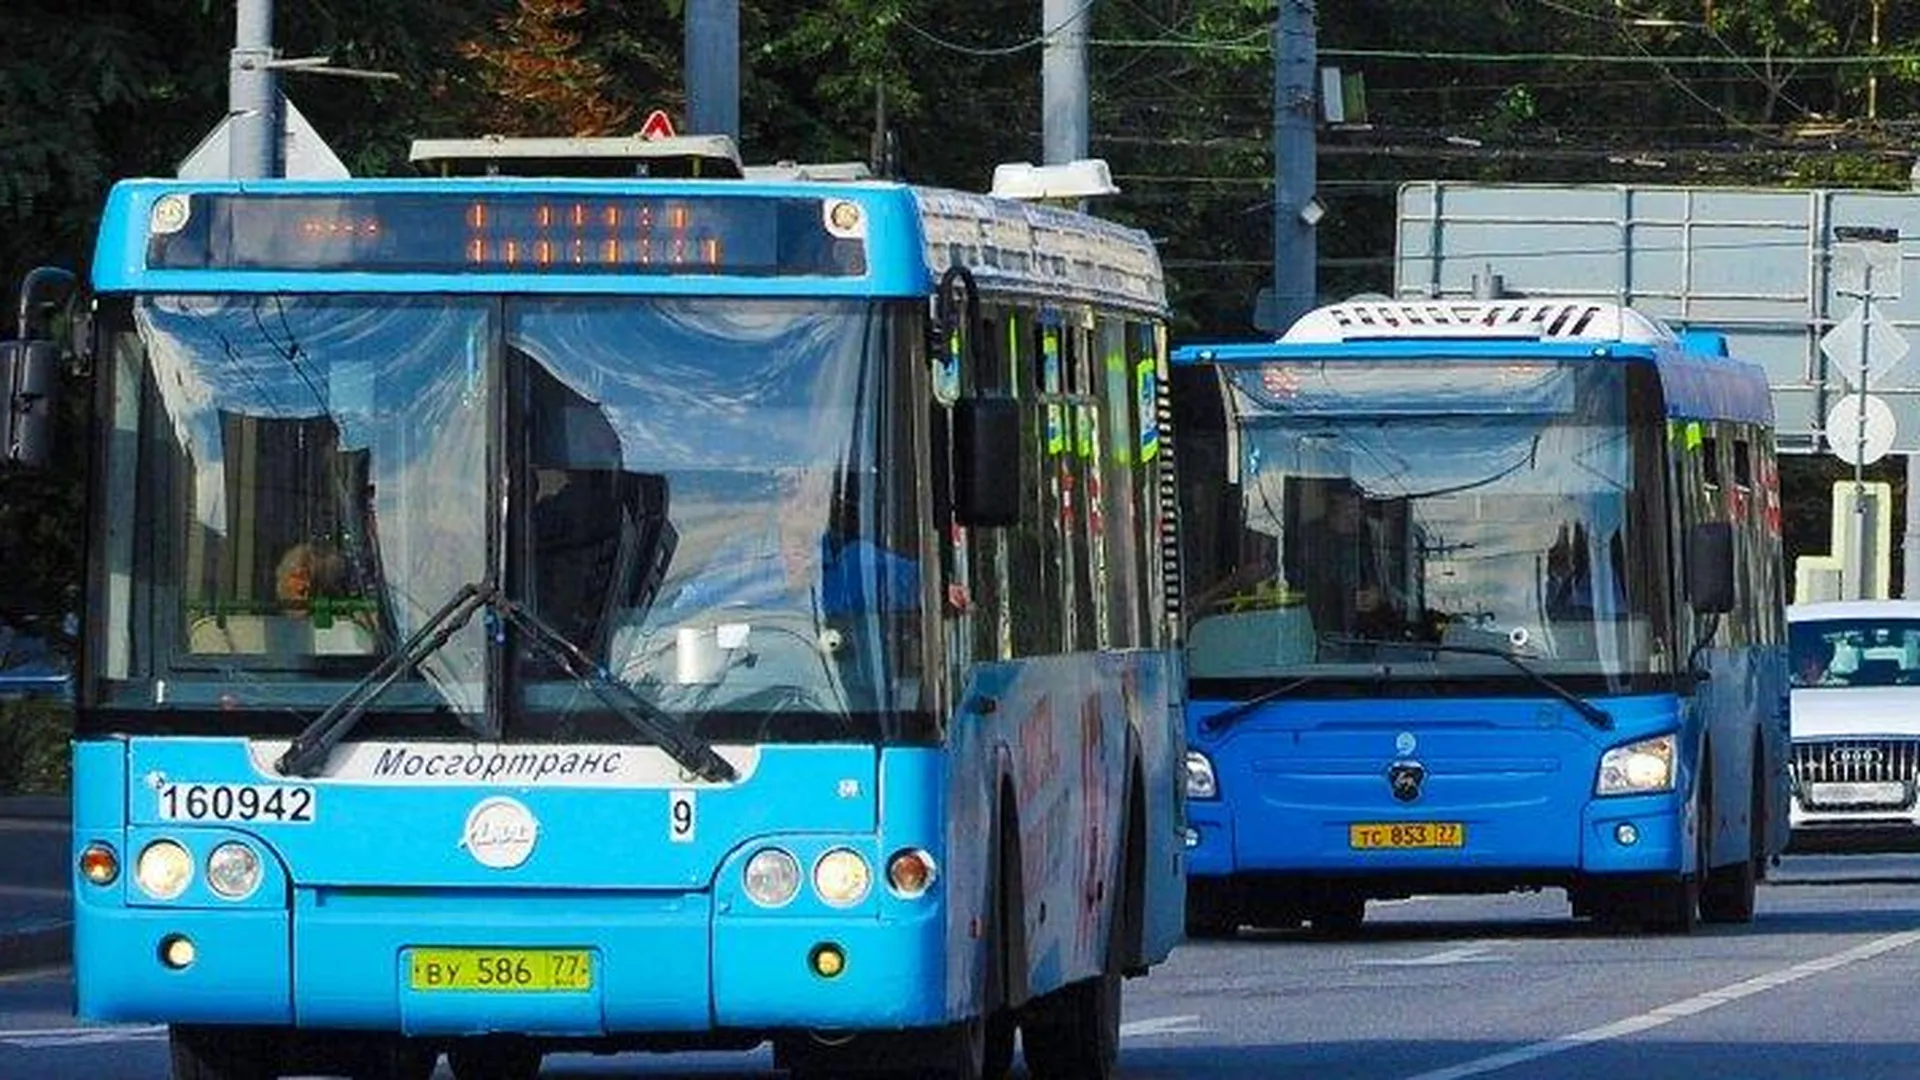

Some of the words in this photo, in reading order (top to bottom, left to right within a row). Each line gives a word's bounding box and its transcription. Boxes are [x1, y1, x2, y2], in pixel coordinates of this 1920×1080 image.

[373, 748, 622, 781] Мосгортранс
[163, 785, 312, 822] 160942
[673, 799, 692, 835] 9
[1391, 825, 1427, 845] 853
[477, 957, 533, 985] 586
[551, 955, 579, 977] 77
